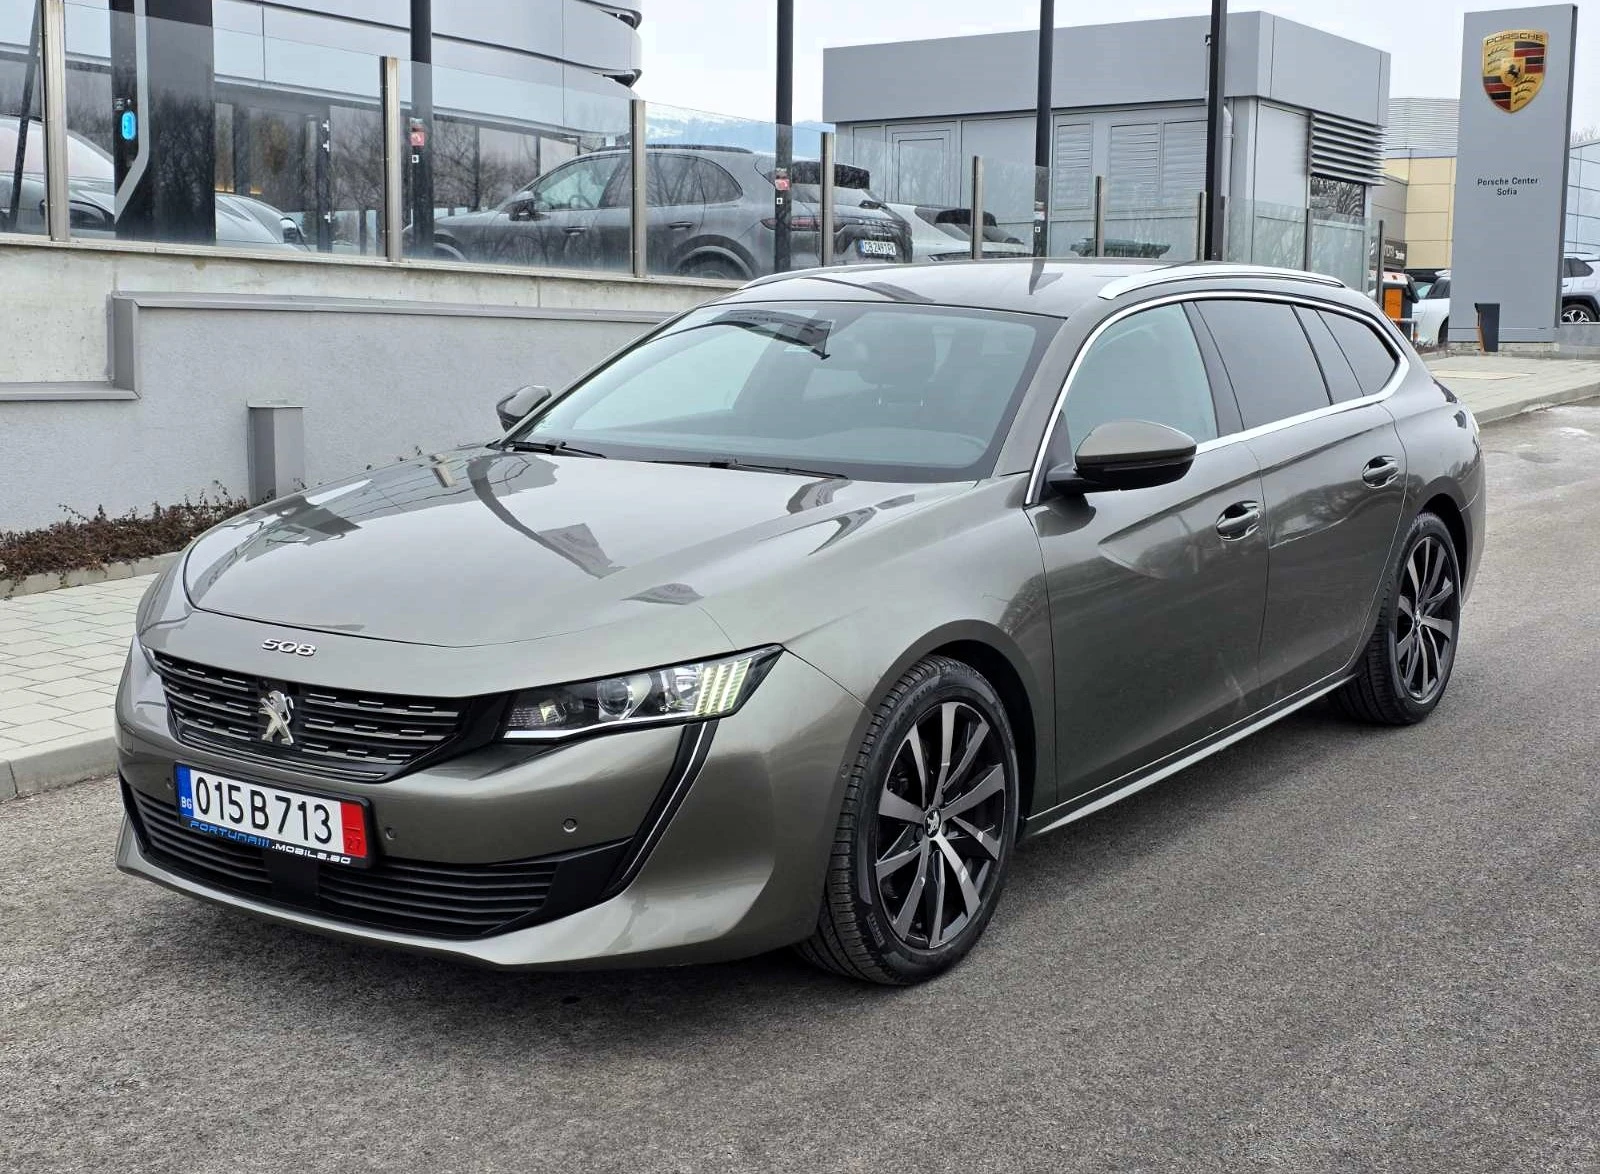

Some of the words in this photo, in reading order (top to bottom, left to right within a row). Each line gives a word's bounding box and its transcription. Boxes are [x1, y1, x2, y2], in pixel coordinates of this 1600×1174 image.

[1487, 32, 1544, 45] PORSCHE
[1477, 178, 1509, 186] Porsche
[1512, 176, 1538, 185] Center
[1497, 187, 1517, 196] Sofia
[262, 638, 316, 656] 508
[181, 796, 193, 809] BG
[196, 776, 332, 844] 015B713
